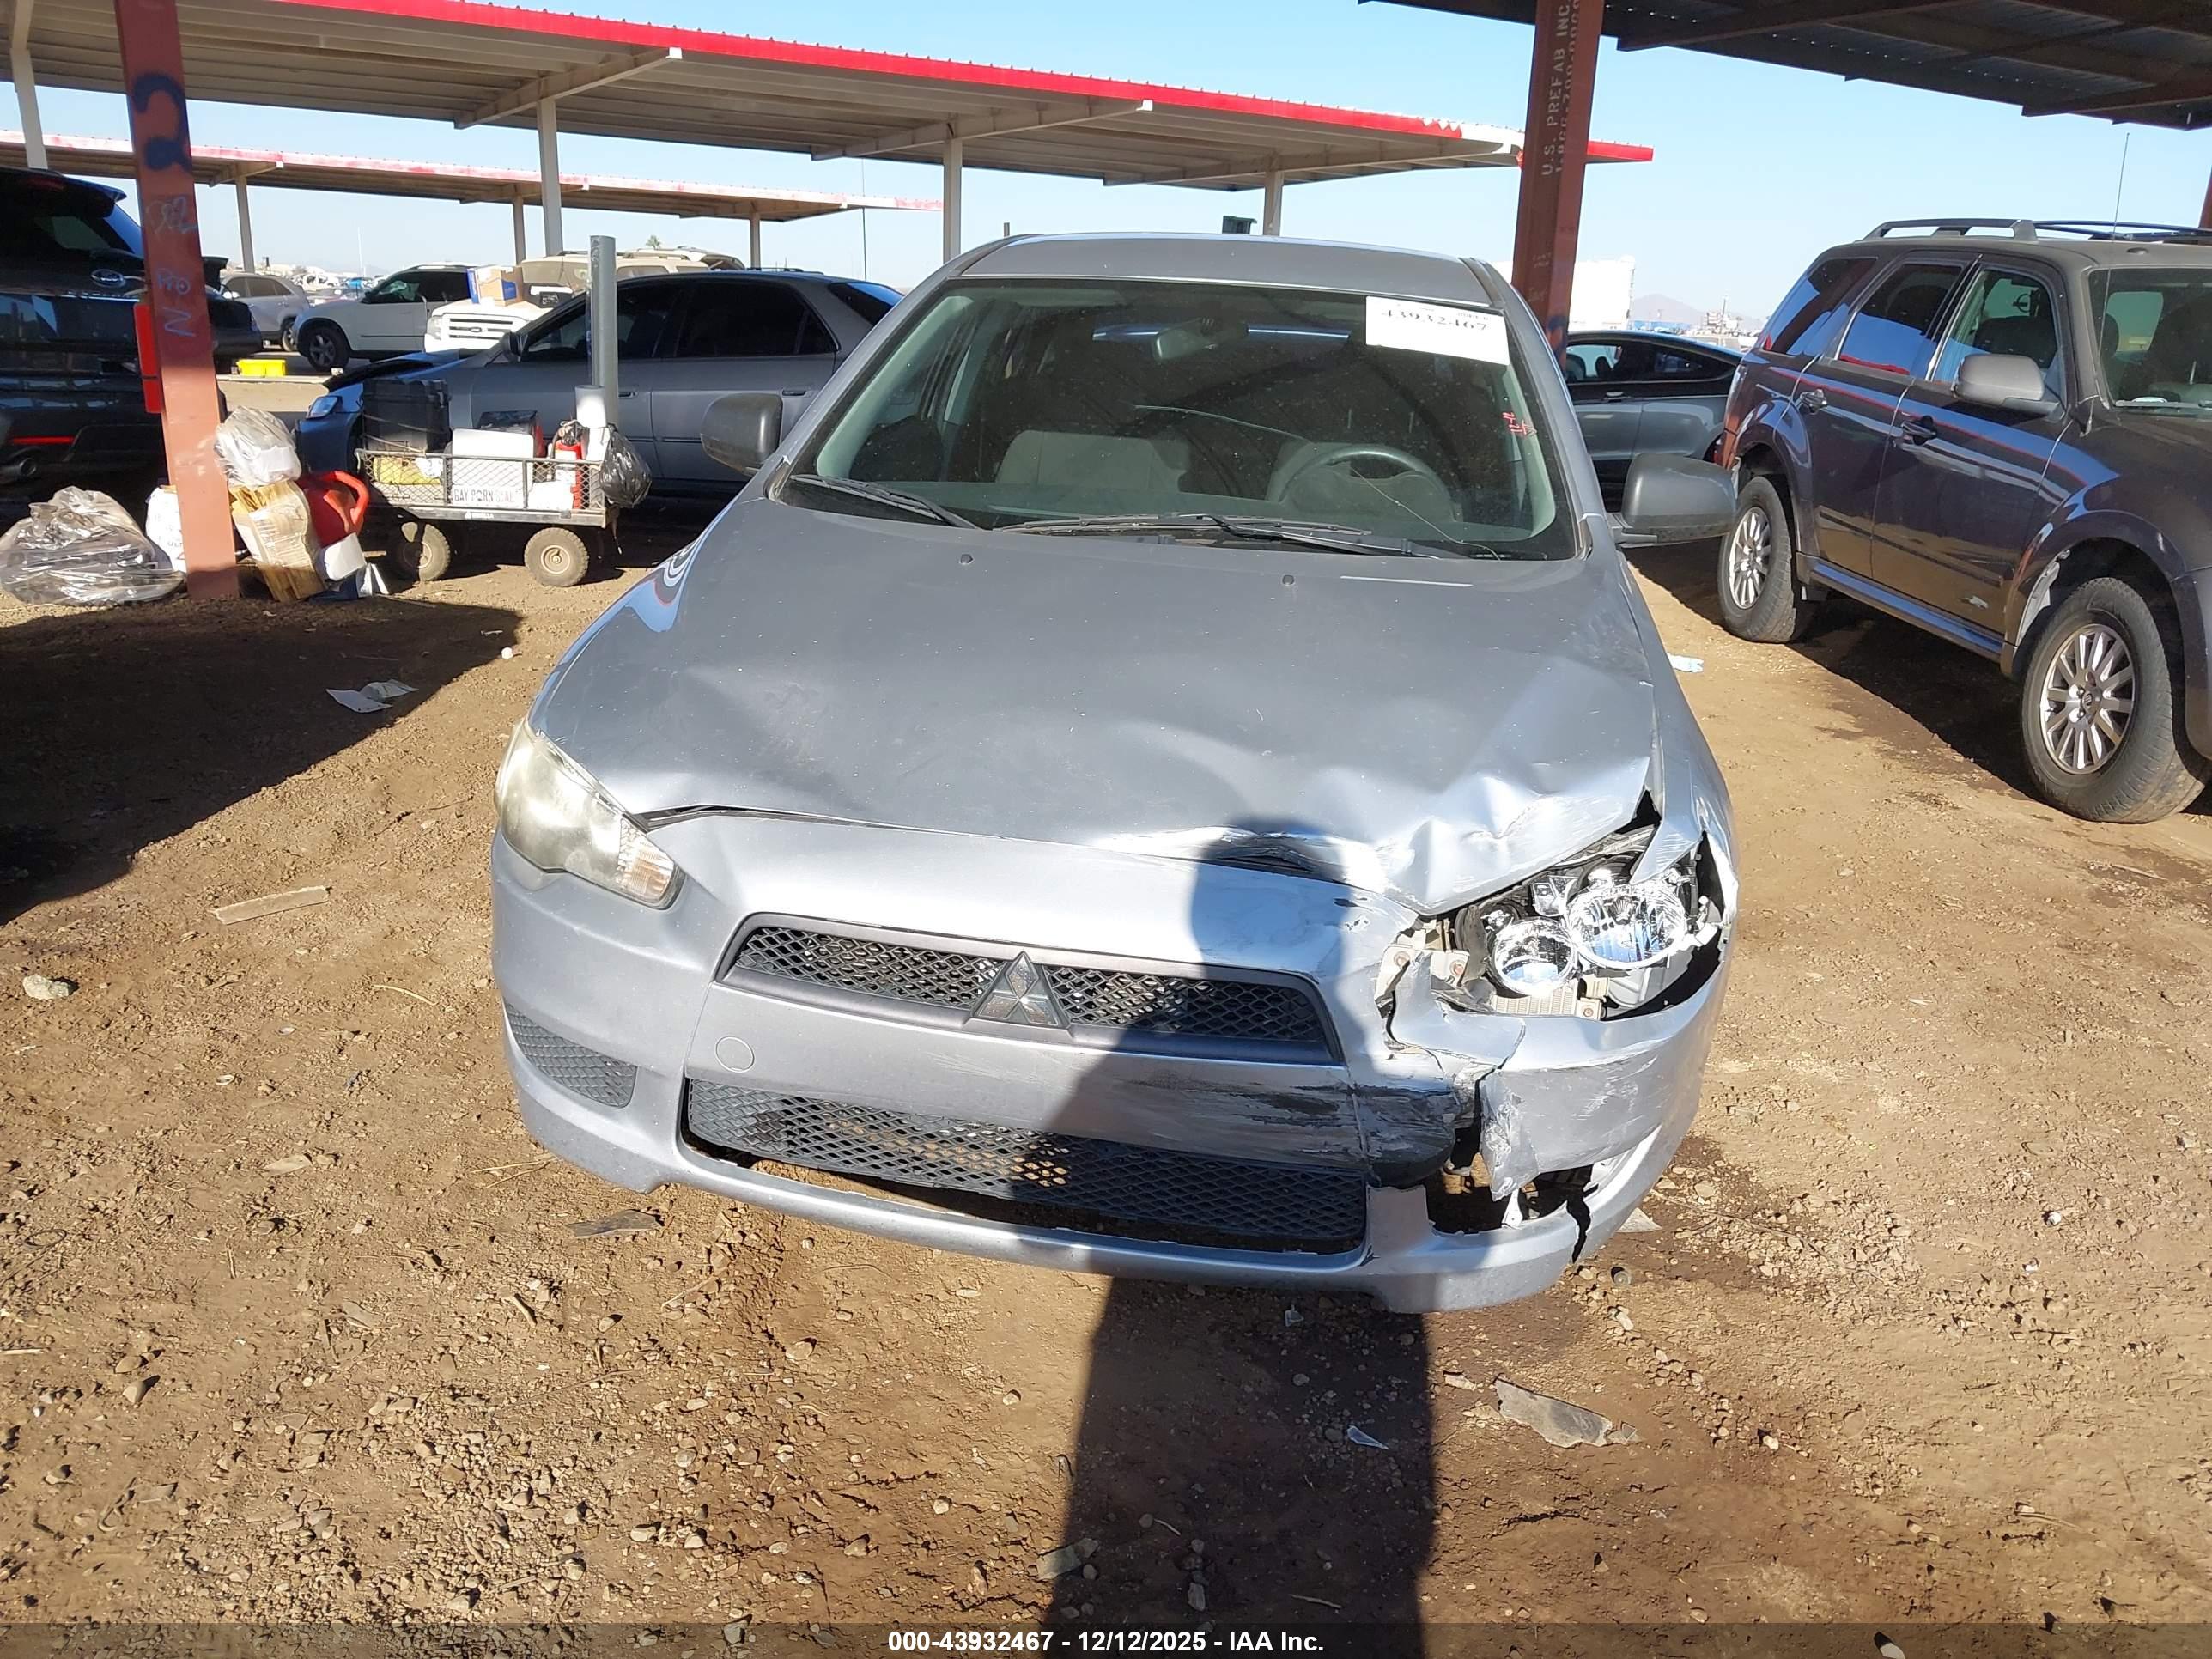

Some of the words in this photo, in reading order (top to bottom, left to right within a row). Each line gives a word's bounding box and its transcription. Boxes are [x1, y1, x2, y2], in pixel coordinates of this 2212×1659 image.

[1546, 46, 1566, 126] PREFAB
[1541, 137, 1557, 175] U.S.
[453, 489, 469, 502] GAY
